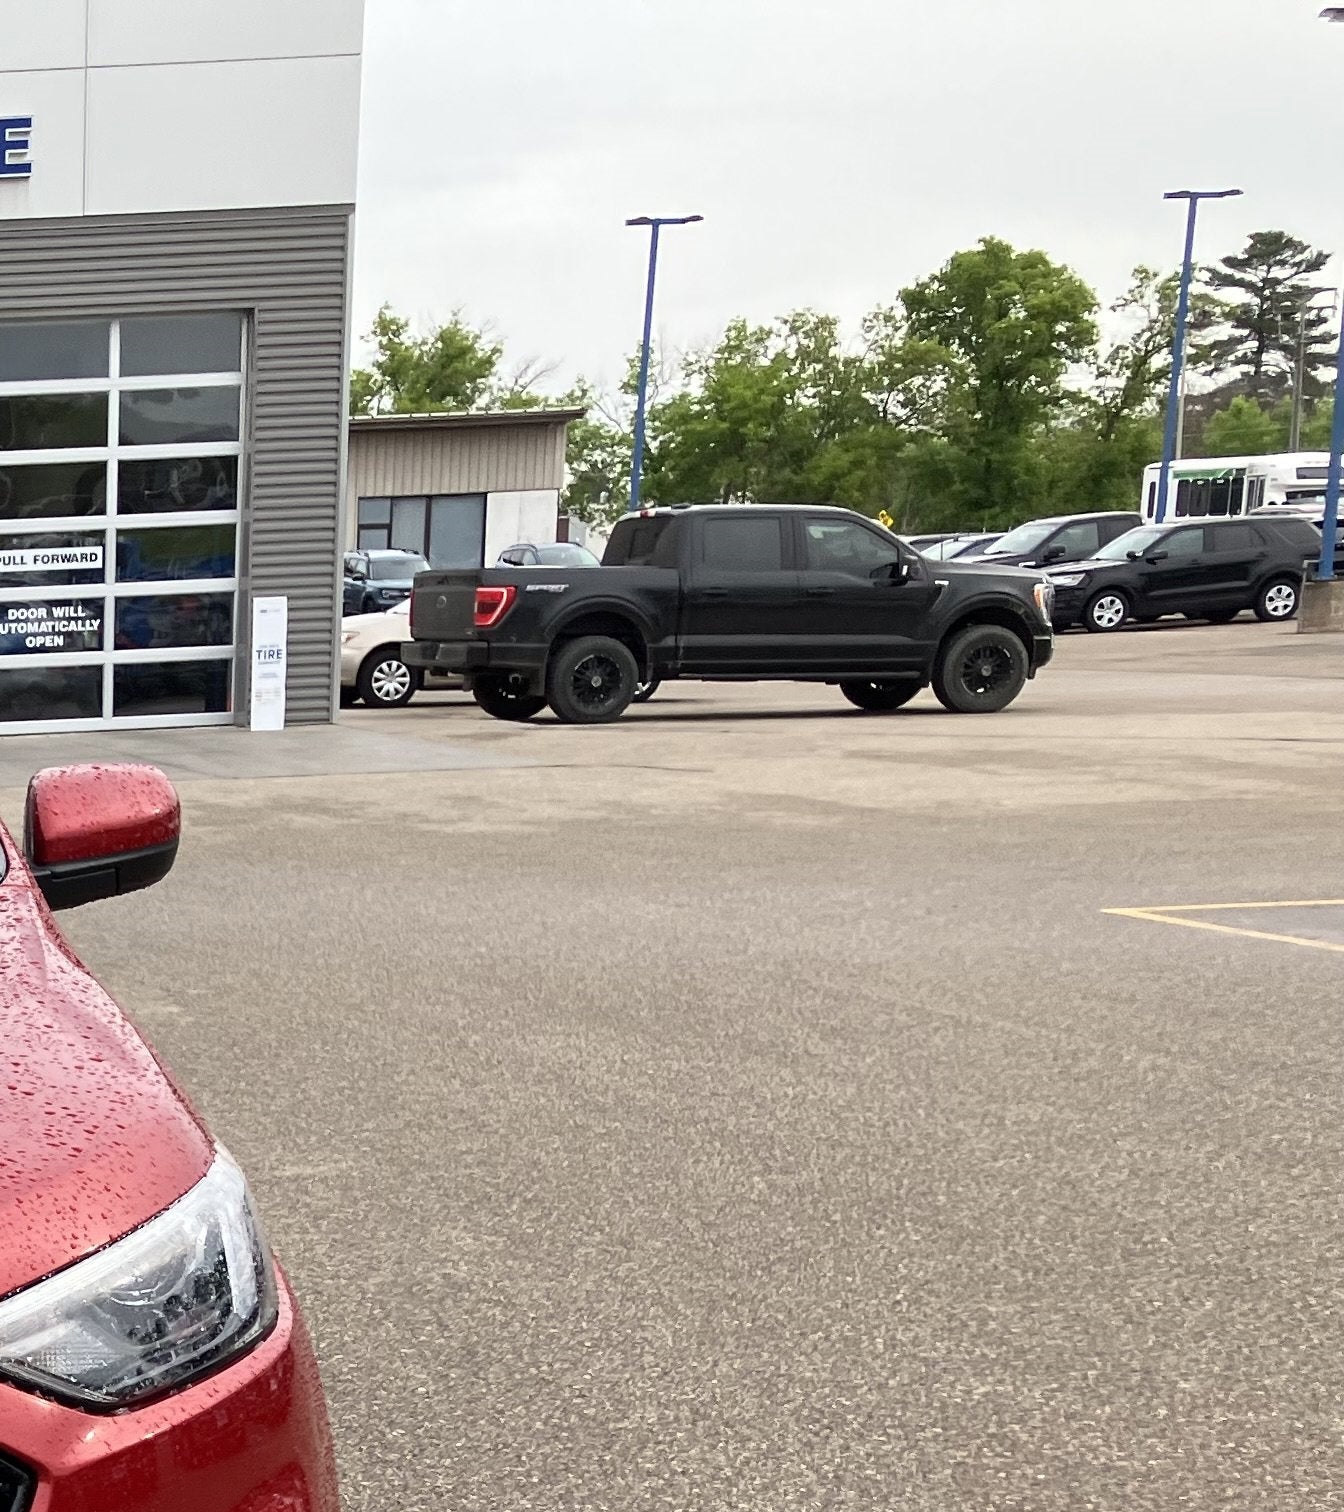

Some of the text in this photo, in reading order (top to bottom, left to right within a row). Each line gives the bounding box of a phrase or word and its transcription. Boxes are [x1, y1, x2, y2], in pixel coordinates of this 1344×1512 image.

[33, 552, 98, 564] FORWARD
[8, 606, 86, 620] DOOR WILL
[25, 635, 64, 647] OPEN
[256, 649, 283, 660] TIRE
